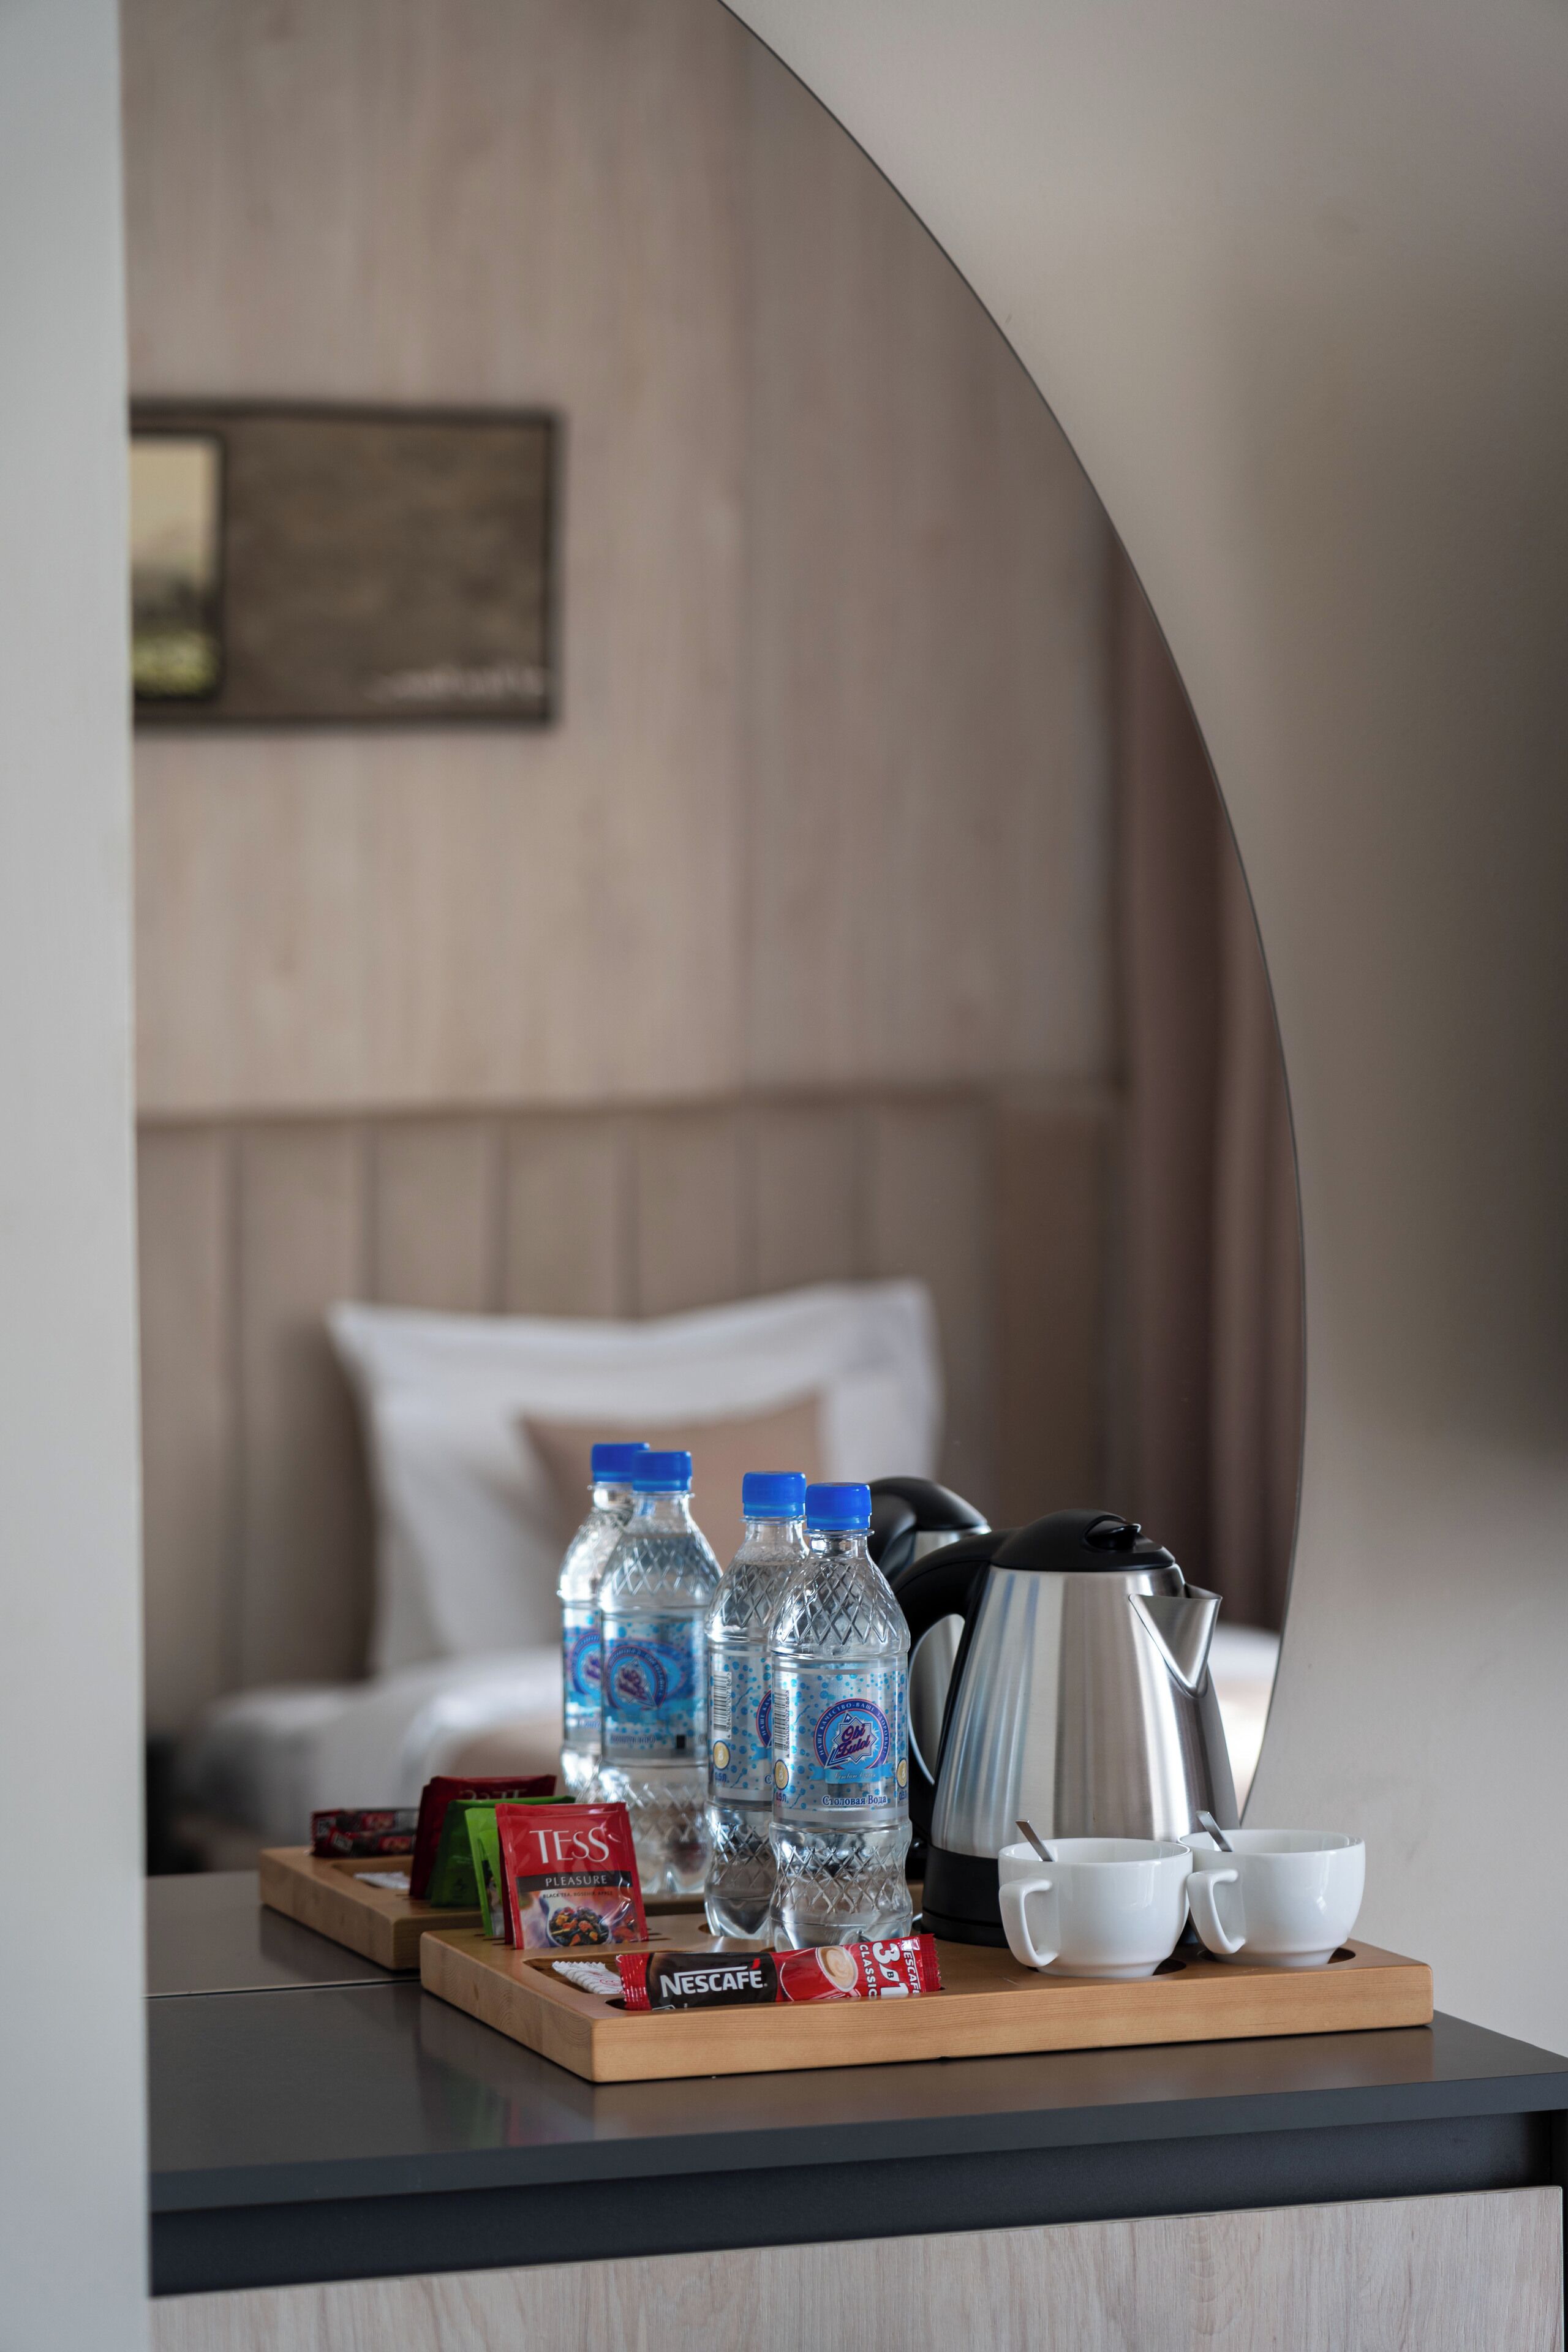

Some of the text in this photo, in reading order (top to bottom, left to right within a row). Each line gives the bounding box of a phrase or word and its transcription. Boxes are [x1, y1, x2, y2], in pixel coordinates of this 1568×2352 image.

[823, 1795, 886, 1806] Столовая Вода
[529, 1826, 609, 1864] TESS
[545, 1875, 608, 1887] PLEASURE
[872, 1942, 900, 1964] 3
[859, 1944, 877, 1997] CLASSIC
